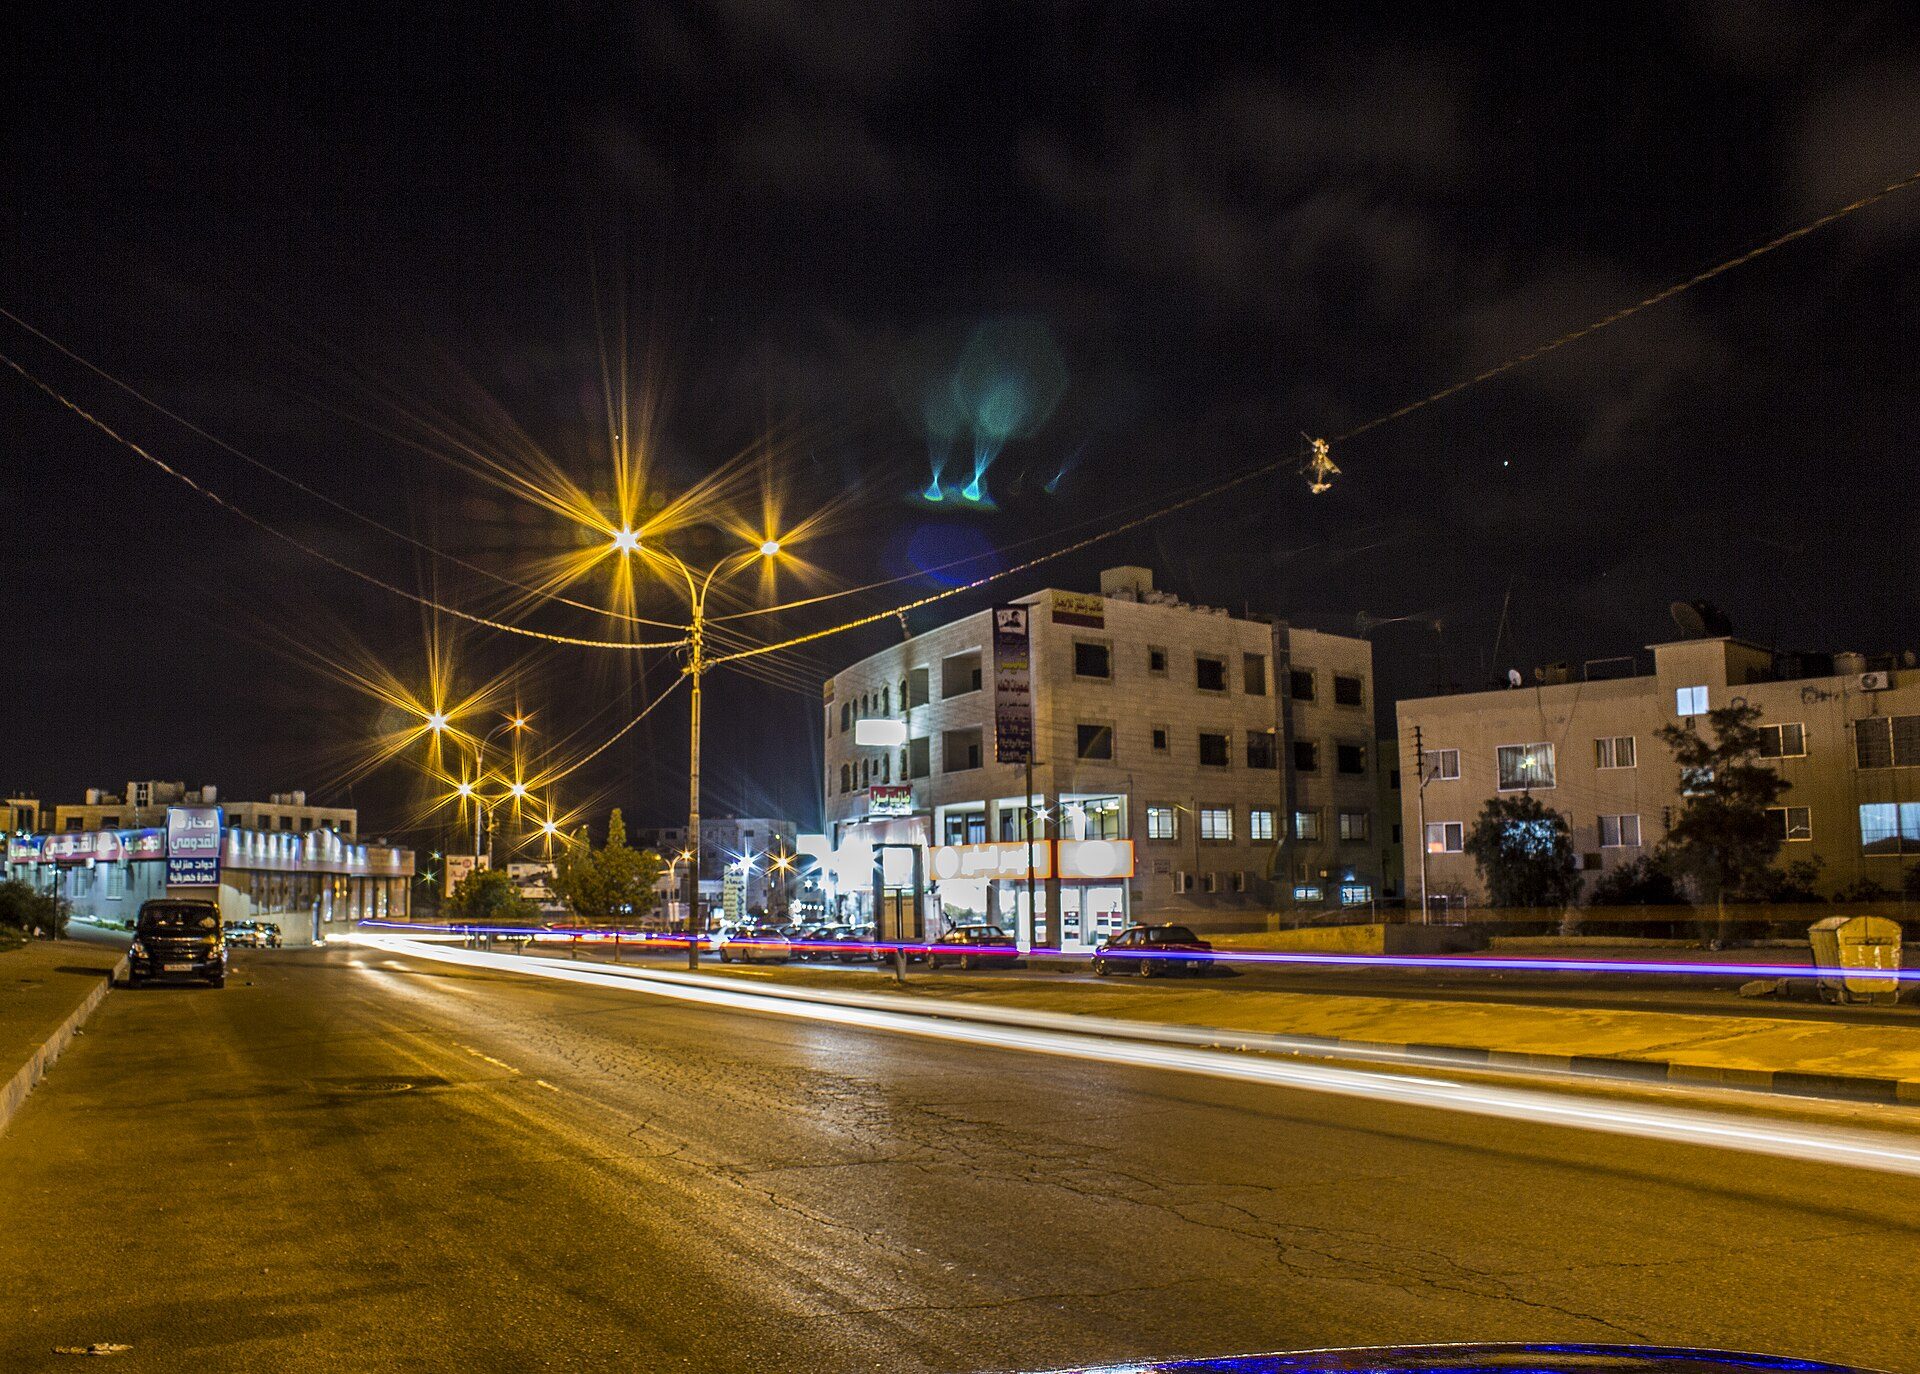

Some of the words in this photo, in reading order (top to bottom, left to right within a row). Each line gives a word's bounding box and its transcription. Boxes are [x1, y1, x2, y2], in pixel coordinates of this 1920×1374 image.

[171, 833, 218, 854] القدومي
[169, 859, 194, 872] منزلية
[195, 857, 217, 870] أدوات
[196, 870, 217, 884] أجهزة
